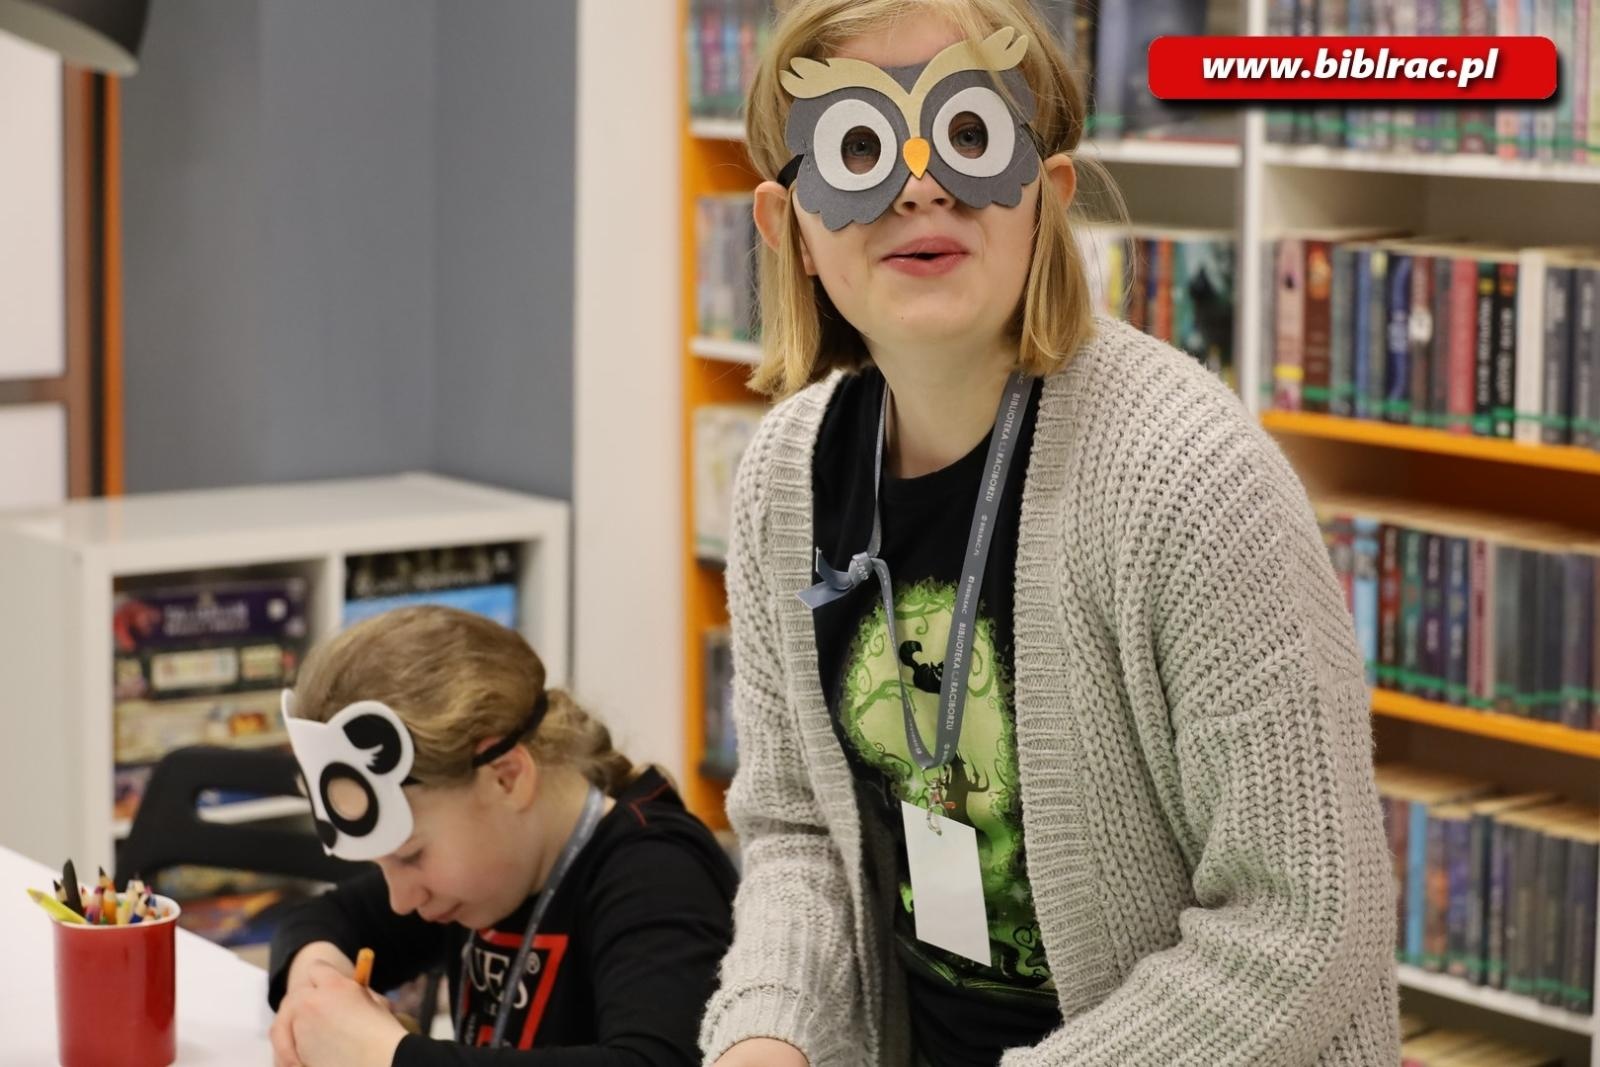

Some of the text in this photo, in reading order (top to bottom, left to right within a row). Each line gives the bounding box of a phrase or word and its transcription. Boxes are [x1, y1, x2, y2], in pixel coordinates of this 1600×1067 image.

[1001, 393, 1021, 440] BIBLIOTEKA
[946, 622, 967, 731] BIBLIOTEKA RACIBORZU
